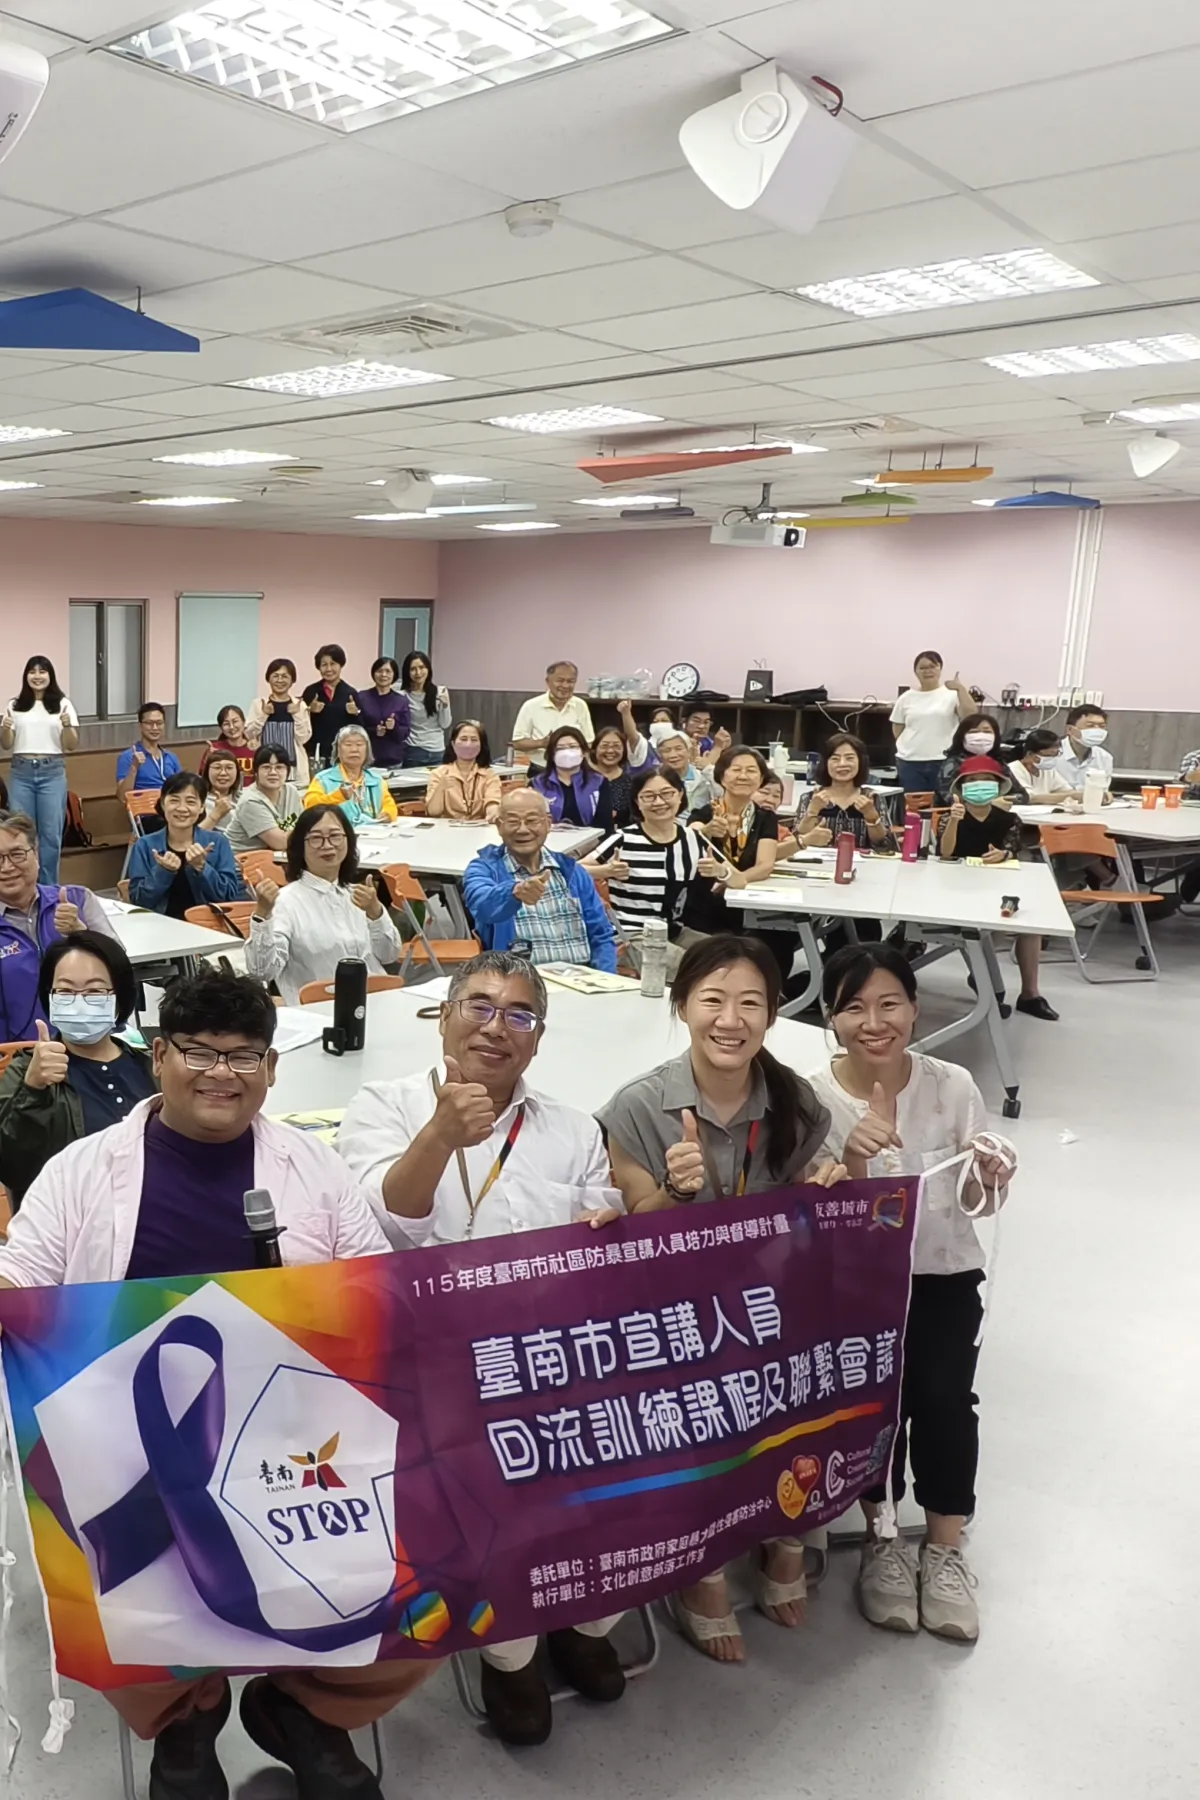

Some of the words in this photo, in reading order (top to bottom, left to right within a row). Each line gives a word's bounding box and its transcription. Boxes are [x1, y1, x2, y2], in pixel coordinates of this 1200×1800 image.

[471, 1285, 783, 1401] 臺南市宣講人員
[486, 1327, 898, 1481] 回流訓練課程及聯繫會議
[264, 1484, 296, 1494] TAINAN
[267, 1498, 370, 1545] STOP
